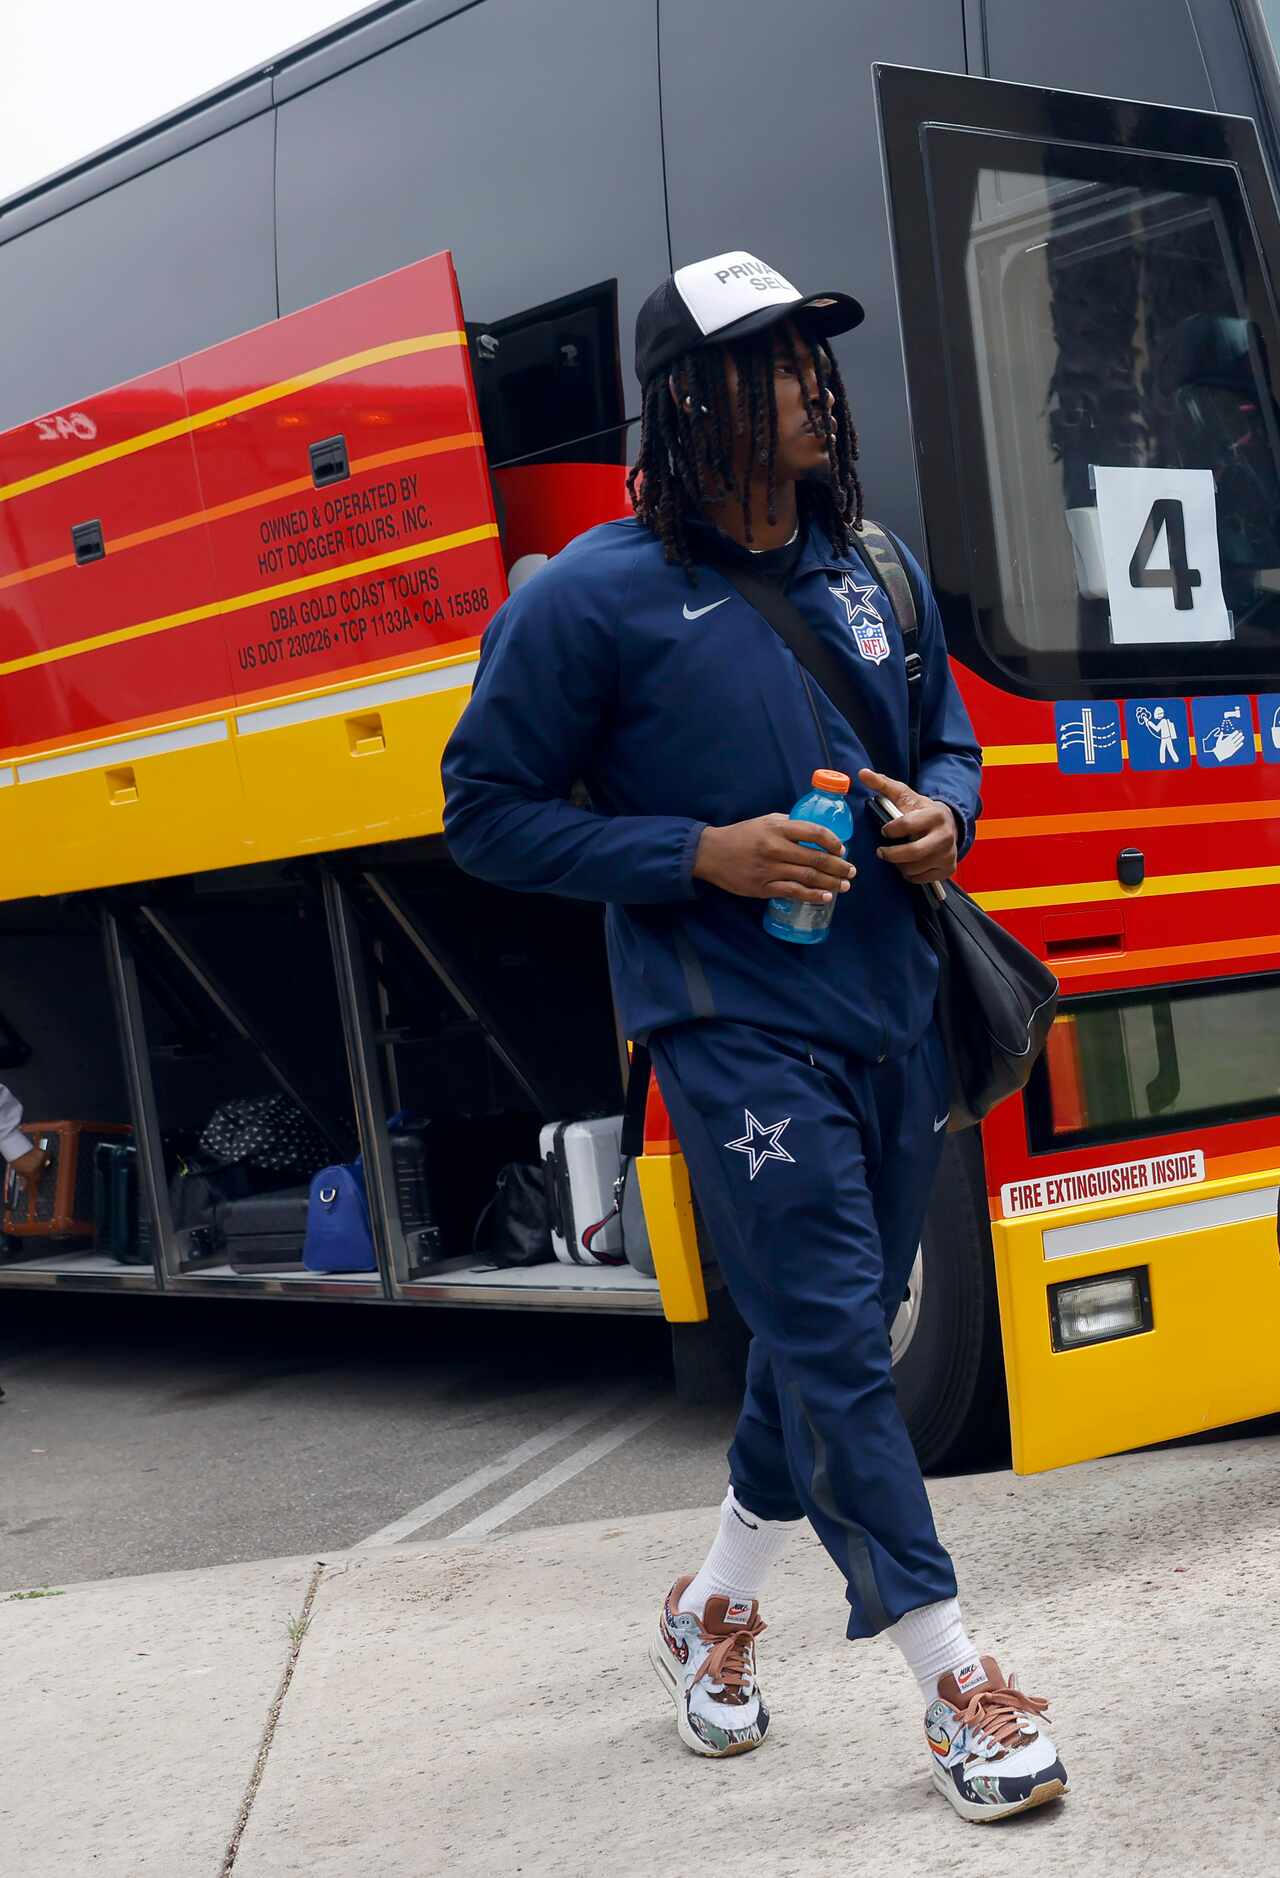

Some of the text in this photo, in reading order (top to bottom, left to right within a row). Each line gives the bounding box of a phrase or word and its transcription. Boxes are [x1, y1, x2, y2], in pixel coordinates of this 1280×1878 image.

[257, 547, 285, 576] HOT
[287, 530, 345, 566] DOGGER
[402, 505, 433, 534] INC.
[259, 474, 419, 544] OWNED & OPERATED BY
[1129, 498, 1202, 610] 4
[238, 587, 489, 670] US DOT 230226 TCP 1133A CA 15588
[269, 566, 440, 632] DBA GOLD COAST TOURS
[862, 639, 887, 656] NFL
[1009, 1155, 1197, 1212] FIRE EXTINGUISHER INSIDE
